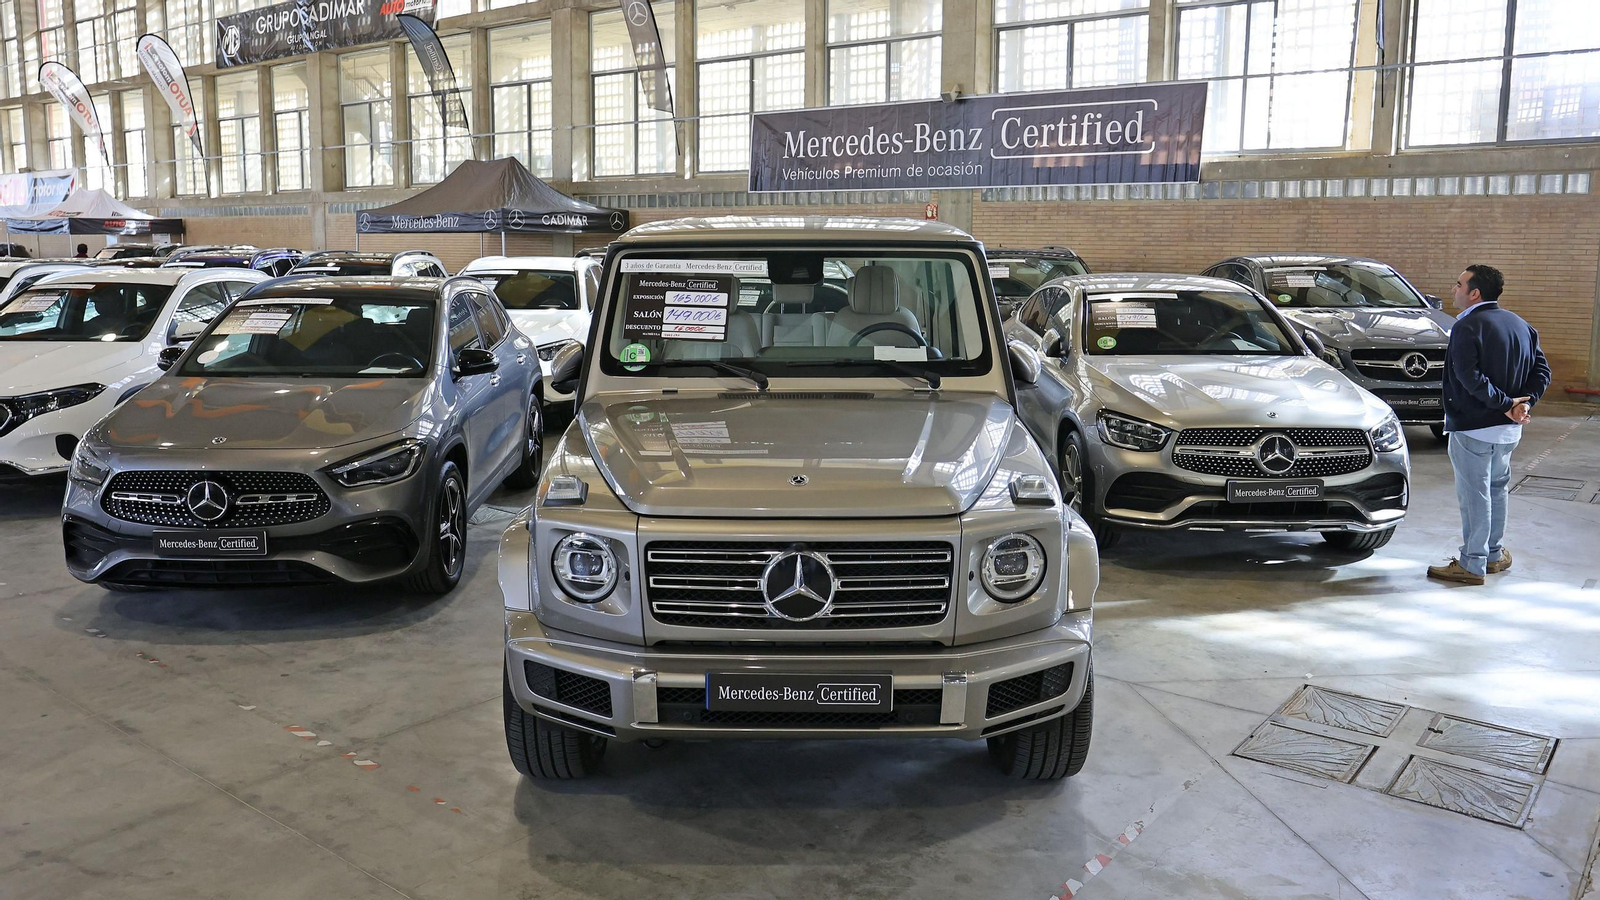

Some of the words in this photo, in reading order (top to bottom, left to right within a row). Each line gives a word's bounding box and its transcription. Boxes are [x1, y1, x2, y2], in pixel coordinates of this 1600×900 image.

[782, 122, 983, 159] Mercedes-Benz
[1000, 110, 1145, 151] Certified
[782, 166, 840, 181] Vehículos
[844, 164, 901, 179] Premium
[906, 163, 923, 177] de
[928, 160, 983, 176] ocasión
[391, 214, 459, 229] Mercedes-Benz
[541, 214, 588, 226] CADIMAR
[685, 262, 732, 271] Mercedes-Benz
[735, 263, 763, 271] Certified
[639, 279, 686, 288] Mercedes-Benz
[688, 281, 717, 289] Certified
[633, 309, 662, 318] SALÓN
[1234, 488, 1285, 497] Mercedes-Benz
[1287, 486, 1317, 496] Certified
[159, 539, 218, 549] Mercedes-Benz
[221, 539, 256, 549] Certified
[718, 685, 814, 701] Mercedes-Benz
[820, 686, 877, 701] Certified
